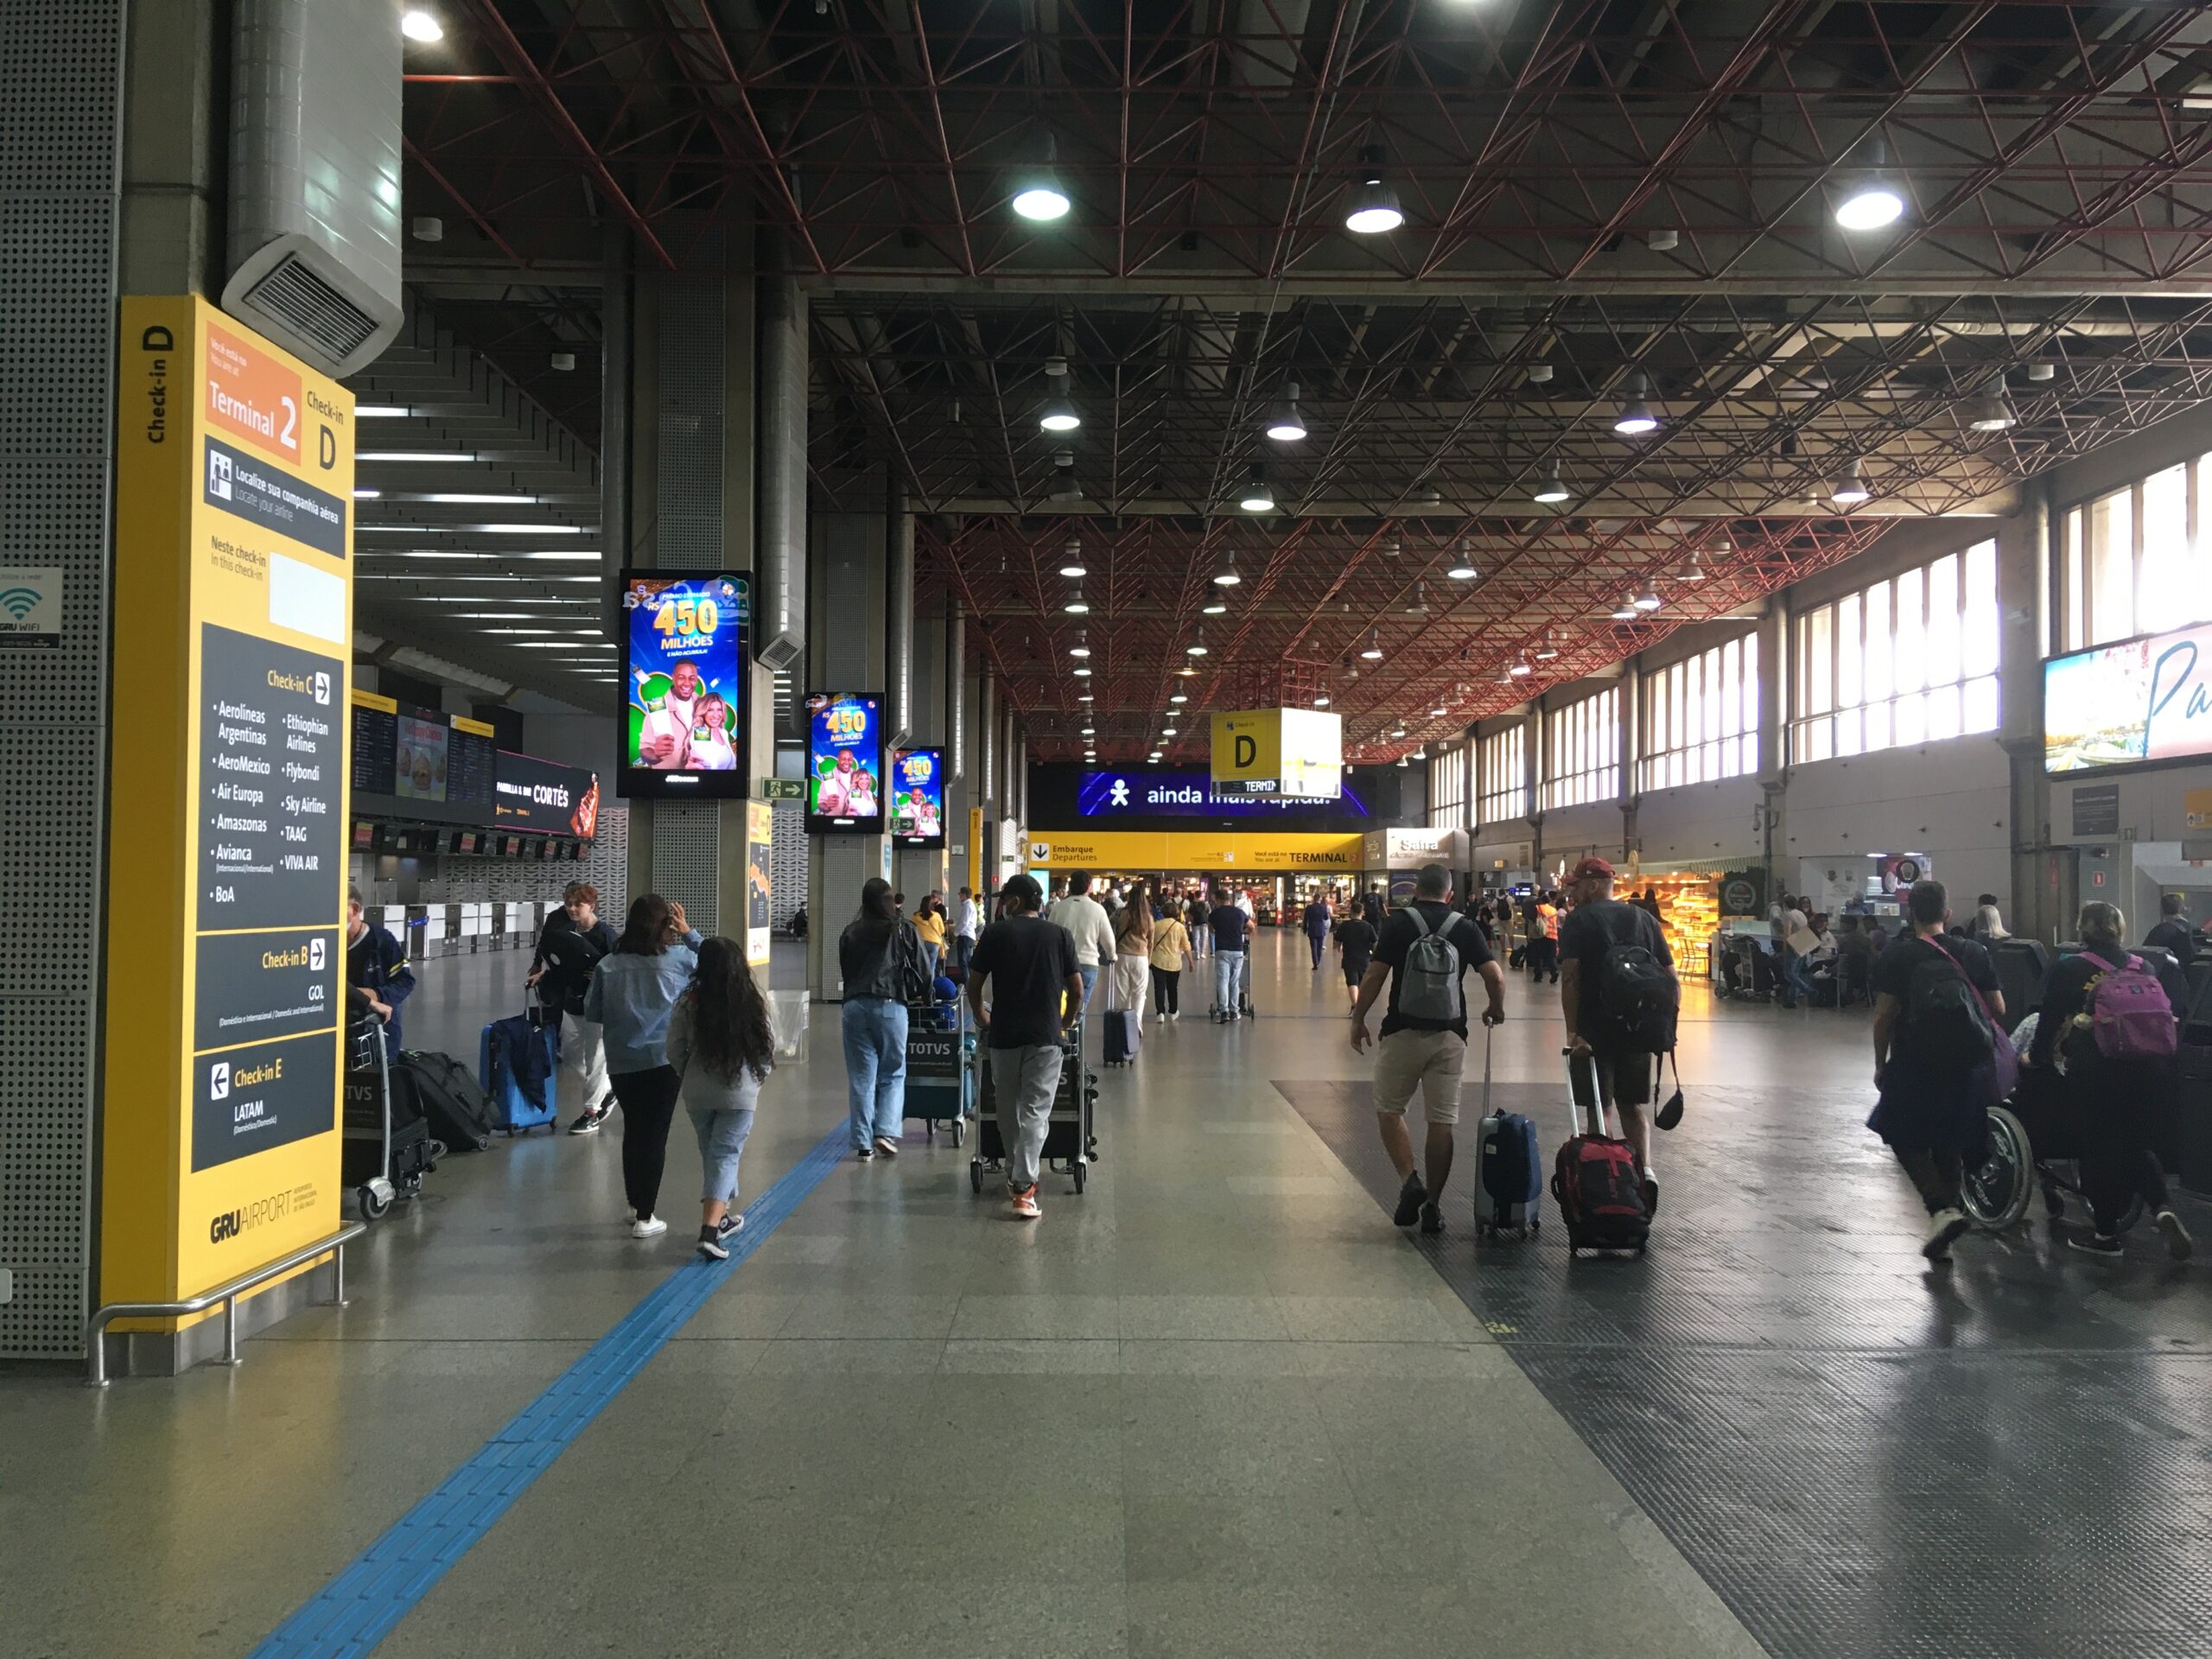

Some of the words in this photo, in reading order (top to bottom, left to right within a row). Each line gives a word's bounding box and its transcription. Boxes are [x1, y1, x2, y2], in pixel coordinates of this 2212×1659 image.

[143, 325, 174, 351] D
[148, 359, 166, 443] Check-in
[307, 390, 344, 425] Check-in
[209, 380, 275, 439] Terminal
[280, 396, 297, 450] 2
[320, 423, 336, 470] D
[235, 465, 267, 492] Localize
[267, 481, 281, 499] sua
[282, 489, 320, 516] companhia
[320, 506, 339, 524] aérea
[235, 484, 257, 507] Locate
[258, 498, 273, 513] your
[274, 502, 294, 523] airline
[211, 535, 235, 556] Neste
[235, 544, 266, 568] check-in
[211, 552, 219, 565] In
[219, 556, 234, 572] this
[234, 562, 263, 582] check-in
[19, 623, 40, 632] WIFI
[653, 599, 718, 636] 450
[661, 634, 713, 650] MILHÕES
[267, 670, 304, 693] Check-in
[306, 676, 313, 695] C
[219, 700, 266, 724] Aerolíneas
[825, 710, 866, 734] 450
[218, 722, 266, 746] Argentinas
[287, 714, 328, 736] Ethiophian
[286, 734, 316, 753] Airlines
[1236, 735, 1256, 768] D
[218, 753, 270, 775] AeroMexico
[286, 762, 320, 783] Flybondi
[903, 760, 931, 776] 450
[217, 782, 232, 800] Air
[232, 784, 264, 807] Europa
[285, 795, 301, 816] Sky
[301, 797, 327, 815] Airline
[533, 784, 569, 808] CORTÉS
[1147, 785, 1202, 804] ainda
[217, 813, 267, 832] Amaszonas
[285, 825, 307, 842] TAAG
[216, 843, 251, 861] Avianca
[1052, 845, 1093, 855] Embarque
[1052, 853, 1097, 861] Departures
[1289, 852, 1348, 863] TERMINAL
[284, 855, 304, 870] VIVA
[304, 855, 318, 871] AIR
[216, 886, 235, 903] BoA
[262, 950, 299, 969] Check-in
[301, 945, 308, 965] B
[308, 985, 324, 1001] GOL
[908, 1042, 950, 1055] TOTVS
[234, 1064, 273, 1088] Check-in
[275, 1058, 283, 1078] E
[344, 1084, 372, 1102] TVS
[234, 1099, 264, 1122] LATAM
